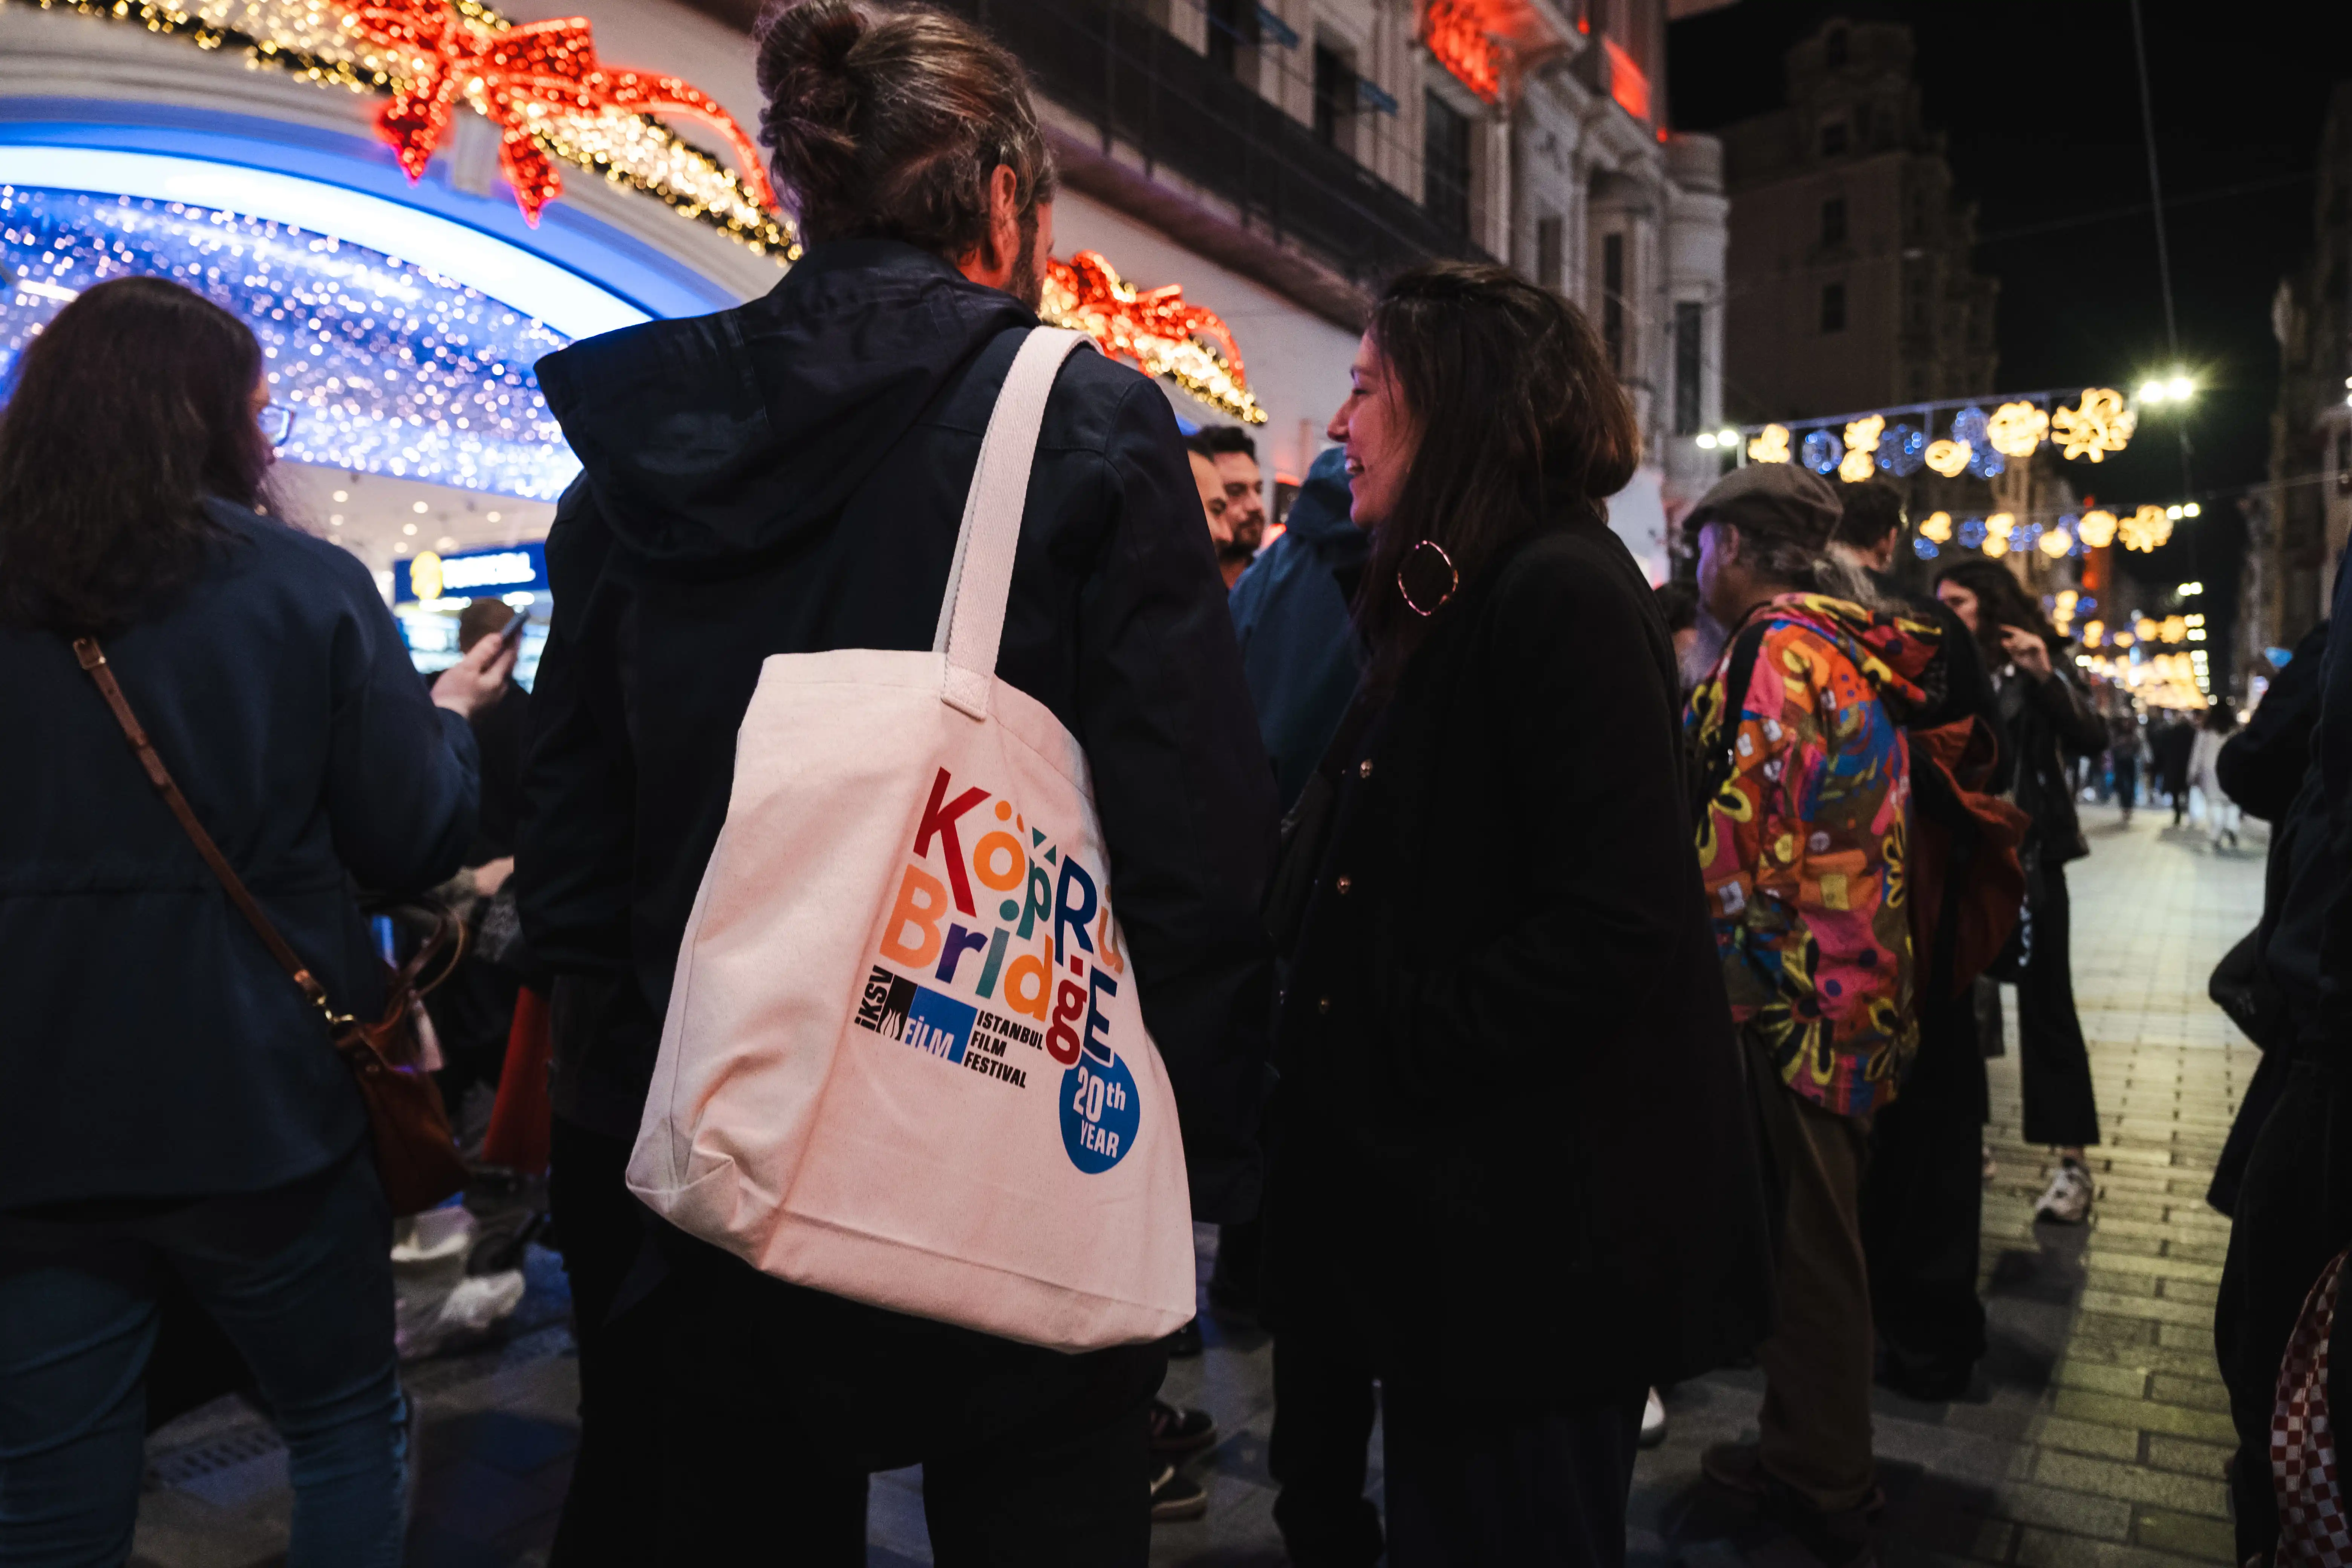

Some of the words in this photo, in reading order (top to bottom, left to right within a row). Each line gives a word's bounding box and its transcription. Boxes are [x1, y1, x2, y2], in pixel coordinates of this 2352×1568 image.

[971, 1031, 1007, 1057] FILM
[977, 1010, 1043, 1050] ISTANBUL
[964, 1051, 1026, 1089] FESTIVAL
[1073, 1066, 1126, 1122] 20th
[1080, 1119, 1119, 1158] YEAR
